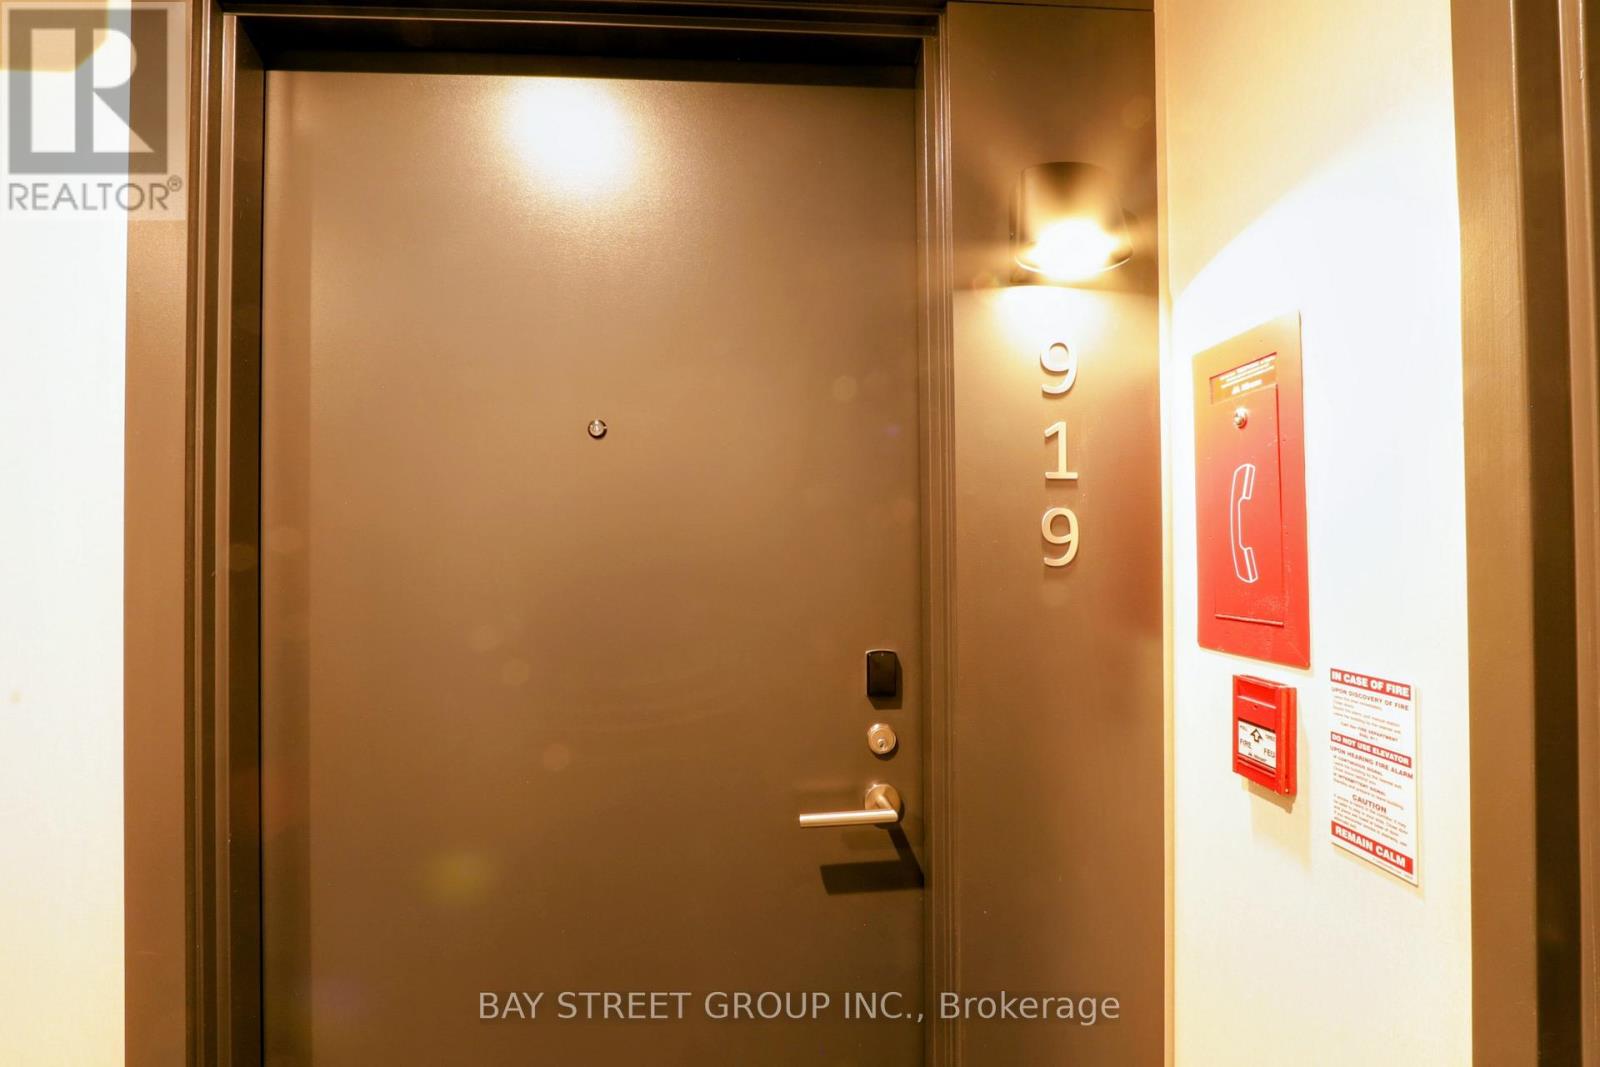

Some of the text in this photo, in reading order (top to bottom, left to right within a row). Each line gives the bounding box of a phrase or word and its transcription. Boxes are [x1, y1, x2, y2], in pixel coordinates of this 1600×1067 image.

[1330, 686, 1347, 695] UPON
[1348, 690, 1383, 704] DISCOVERY
[1384, 699, 1393, 707] OF
[1394, 702, 1409, 711] FIRE
[1331, 670, 1410, 698] IN CASE OF FIRE
[1330, 745, 1346, 755] UPON
[1347, 751, 1374, 765] HEARING
[1375, 761, 1389, 771] FIRE
[1391, 767, 1414, 779] ALARM
[1331, 733, 1341, 742] DO
[1342, 737, 1356, 748] NOT
[1357, 741, 1372, 752] USE
[1372, 746, 1410, 766] ELEVATOR
[1352, 794, 1387, 813] CAUTION
[1335, 825, 1374, 852] REMAIN
[1375, 845, 1406, 868] CALM
